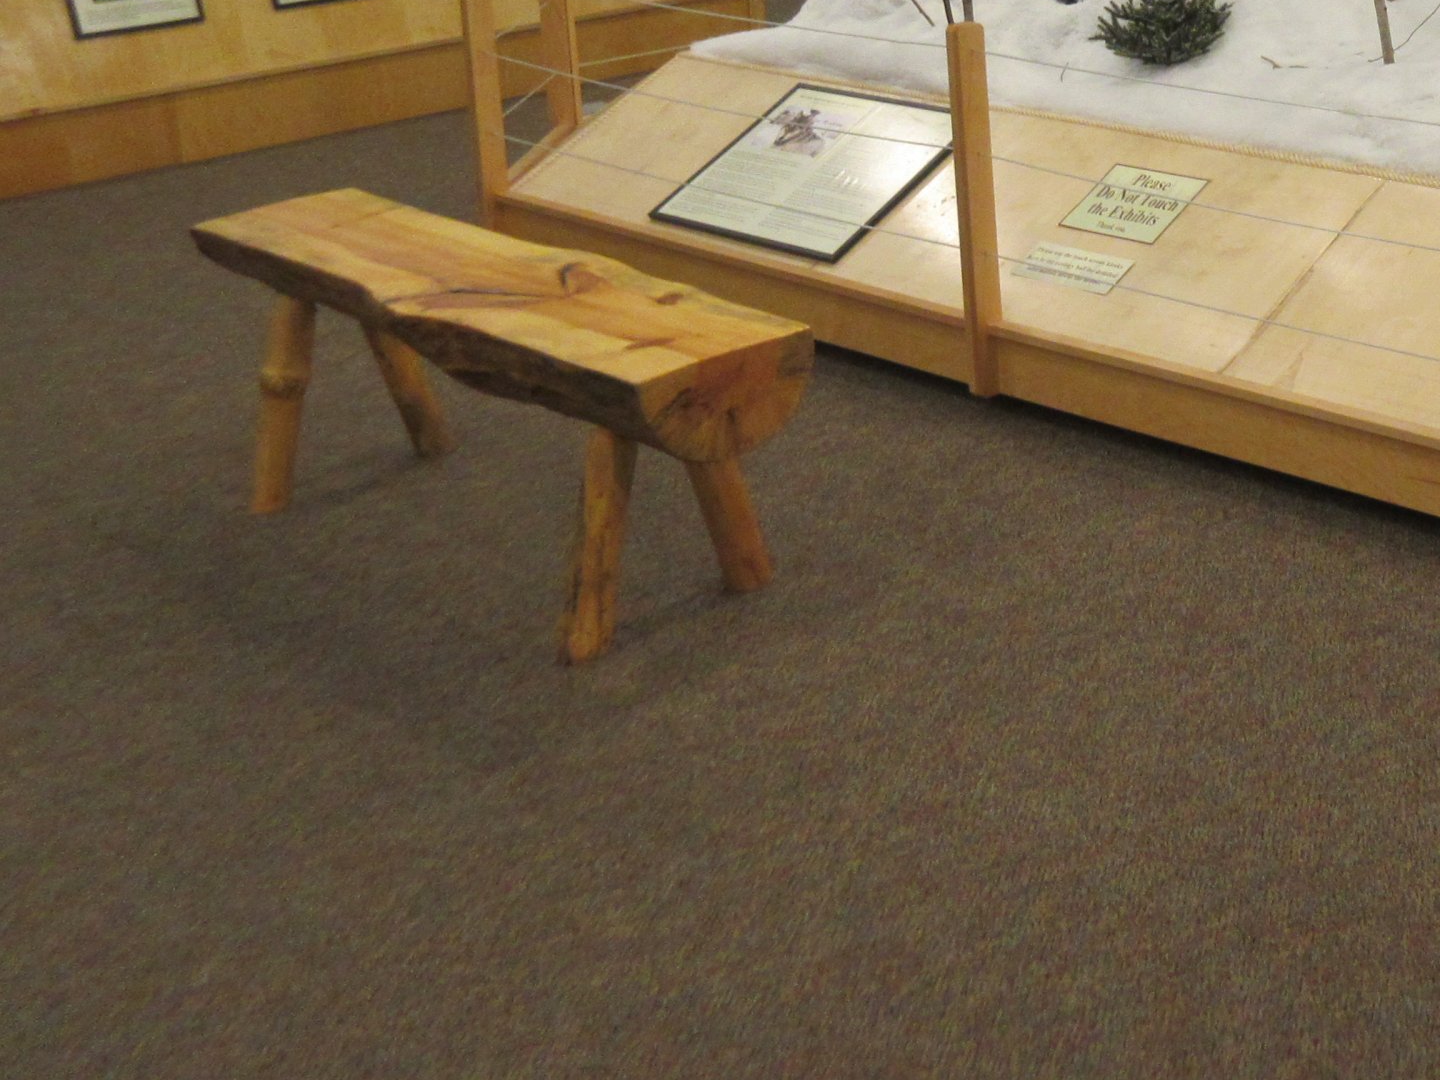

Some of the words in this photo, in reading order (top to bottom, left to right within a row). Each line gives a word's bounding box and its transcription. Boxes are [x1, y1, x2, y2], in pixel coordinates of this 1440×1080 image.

[1131, 174, 1173, 192] Please
[1096, 185, 1115, 199] Do
[1116, 188, 1138, 204] Not
[1139, 193, 1180, 213] Touch
[1087, 202, 1107, 217] the
[1108, 204, 1161, 227] Exhibits
